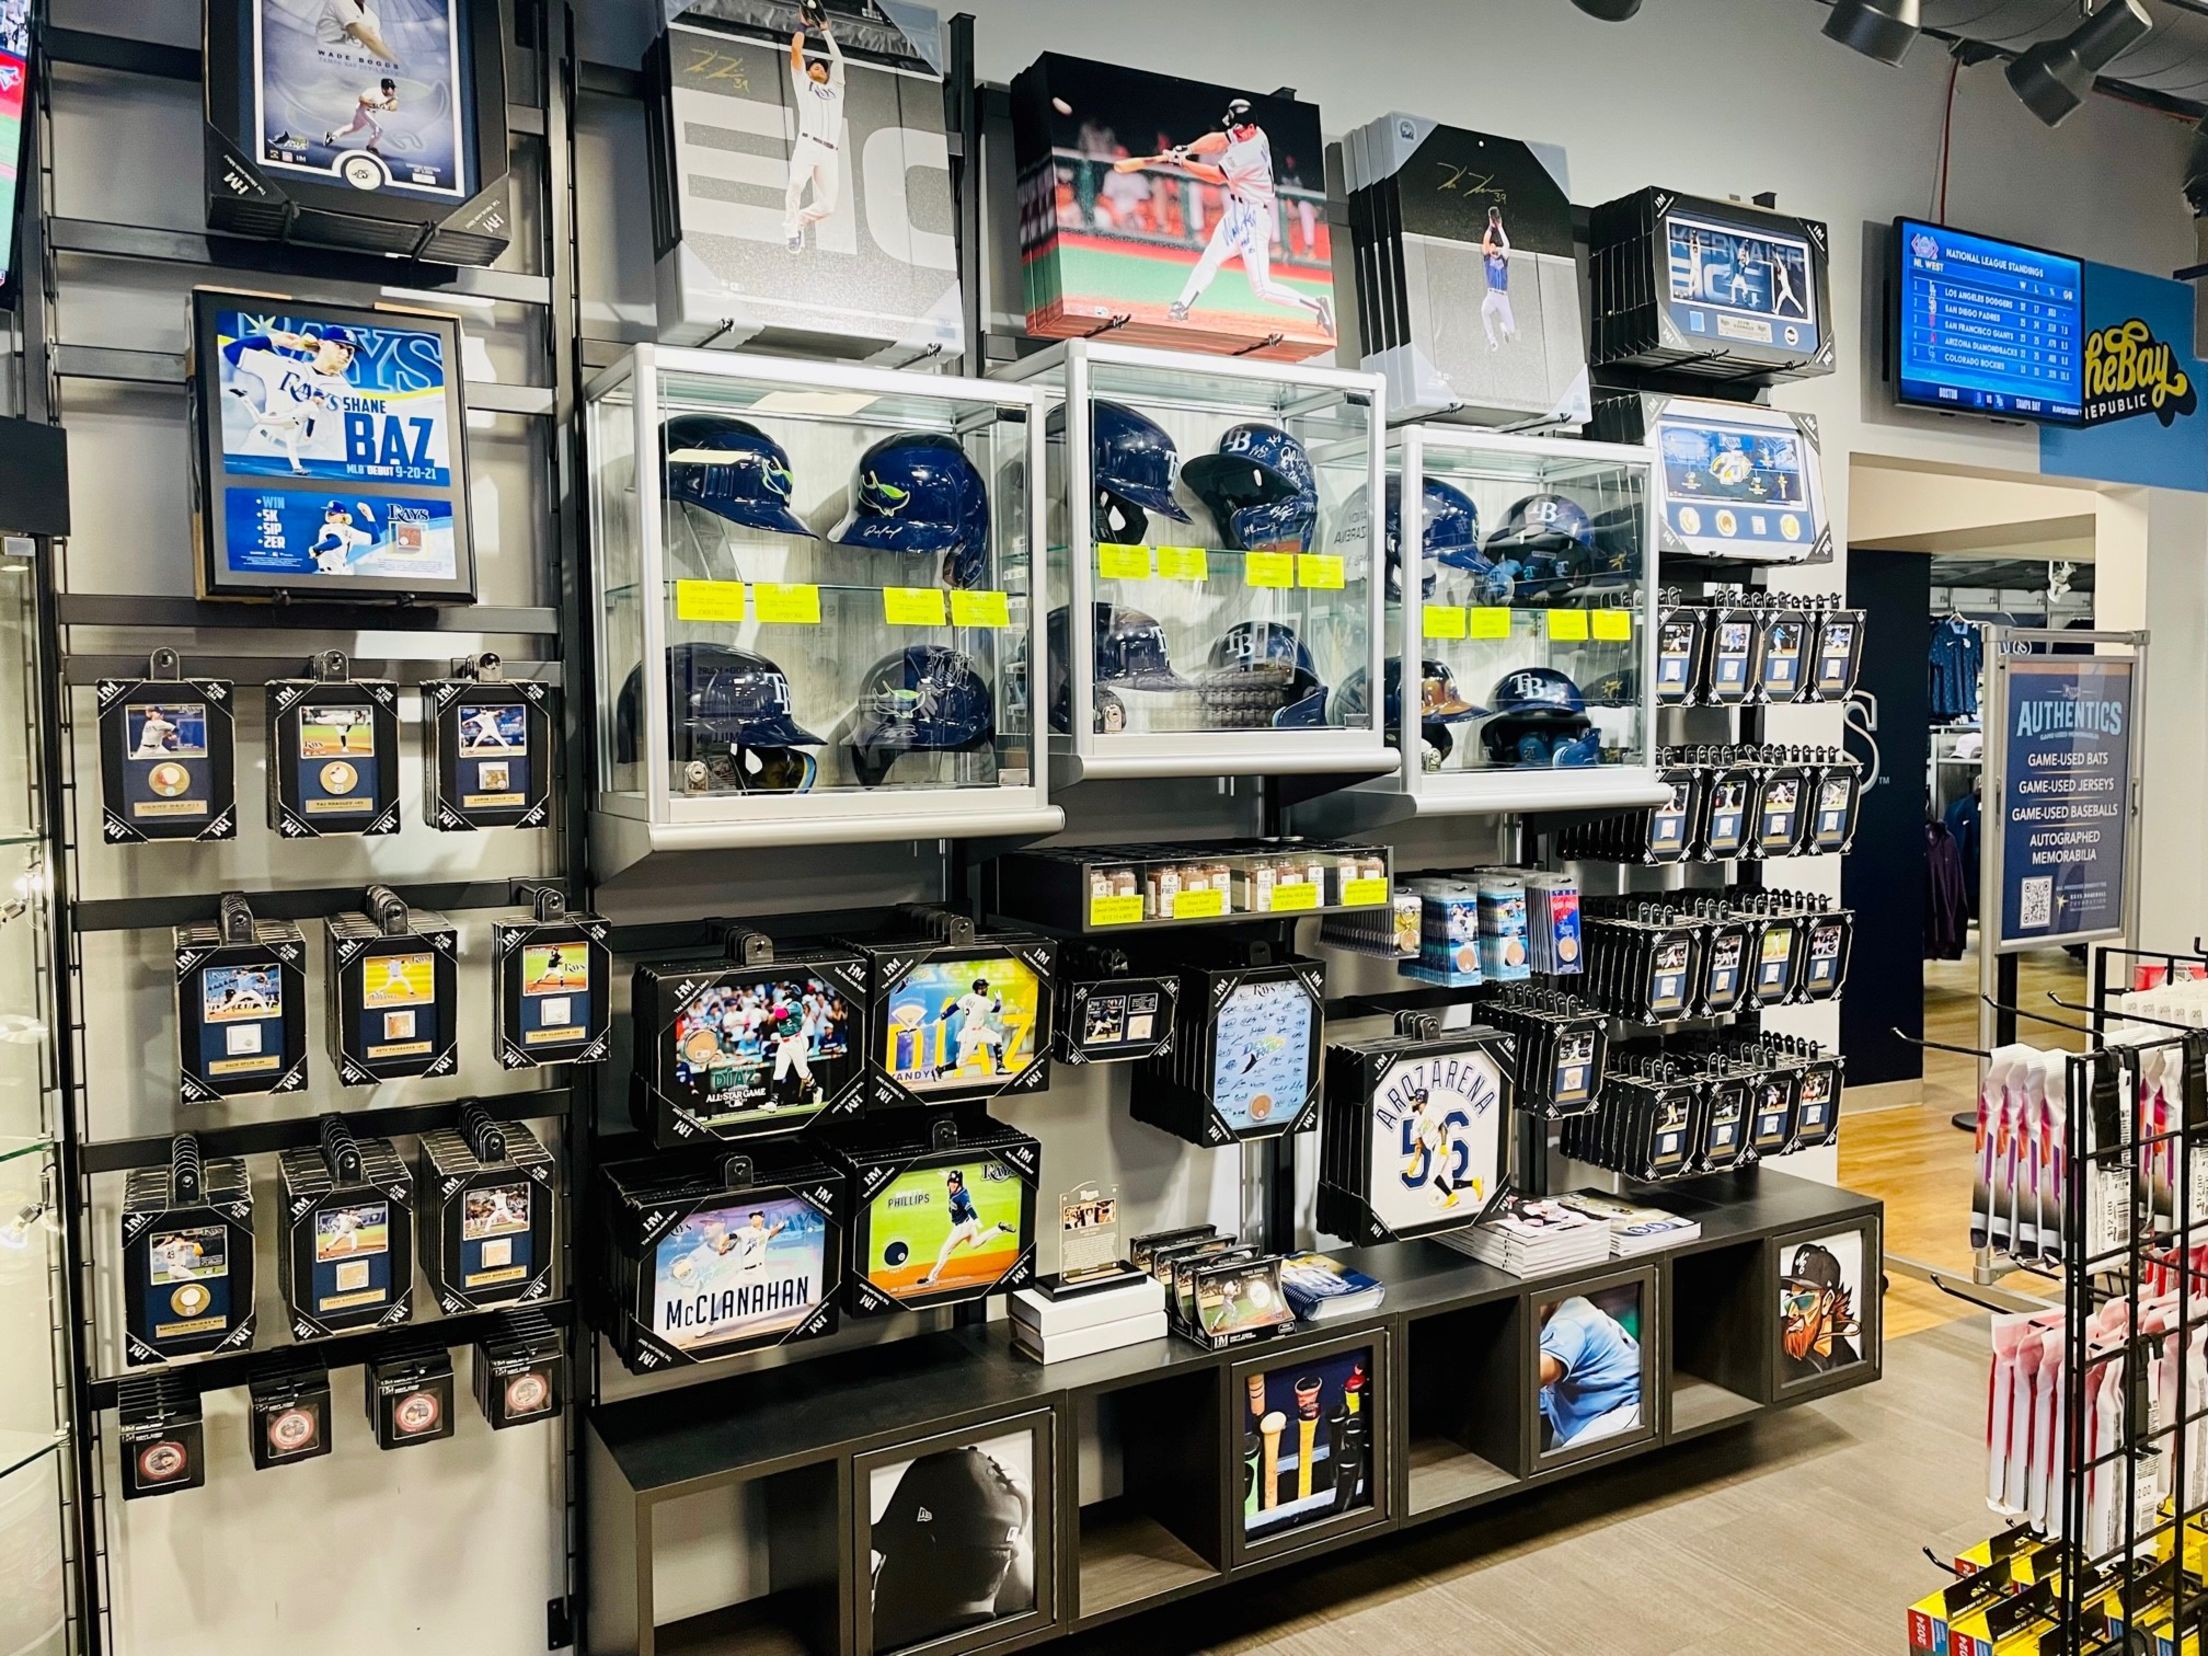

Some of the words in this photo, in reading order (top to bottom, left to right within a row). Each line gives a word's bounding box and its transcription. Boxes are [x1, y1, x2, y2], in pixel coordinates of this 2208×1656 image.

[317, 48, 351, 61] WADE
[358, 57, 400, 70] BOGGS
[223, 172, 250, 195] HM
[482, 213, 505, 233] HM
[1913, 258, 1923, 268] NL
[1925, 260, 1944, 272] WEST
[1945, 248, 1981, 265] NATIONAL
[1981, 256, 2007, 270] LEAGUE
[2007, 262, 2044, 278] STANDINGS
[2019, 281, 2027, 290] W
[1944, 288, 1957, 299] LOS
[1958, 291, 1984, 305] ANGELES
[1984, 295, 2013, 310] DODGERS
[1944, 305, 1958, 315] SAN
[1958, 307, 1978, 318] DIEGO
[1944, 321, 1958, 331] SAN
[1958, 323, 1992, 337] FRANCISCO
[1992, 329, 2014, 340] GIANTS
[1944, 337, 1972, 350] ARIZONA
[1944, 353, 1979, 366] COLORADO
[2084, 320, 2188, 409] heBay
[343, 396, 387, 414] SHANE
[343, 412, 435, 468] BAZ
[367, 465, 394, 477] DEBUT
[395, 467, 437, 480] 9-20-21
[263, 496, 285, 509] WIN
[387, 503, 429, 522] RAYS
[274, 686, 297, 706] HM
[435, 683, 455, 702] HM
[1508, 672, 1547, 701] TB
[2016, 699, 2123, 737] AUTHENTICS
[2027, 752, 2085, 768] GAME-USED
[2086, 751, 2109, 766] BATS
[1878, 776, 1890, 784] TM
[2018, 778, 2077, 794] GAME-USED
[2077, 777, 2115, 792] JERSEYS
[2011, 805, 2069, 822] GAME-USED
[2070, 803, 2118, 818] BASEBALLS
[2029, 830, 2101, 848] AUTOGRAPHED
[2031, 849, 2097, 865] MEMORABILIA
[501, 928, 520, 947] HM
[1033, 947, 1051, 966] HM
[847, 962, 867, 982] HM
[882, 957, 902, 978] HM
[673, 978, 696, 999] HM
[1213, 978, 1229, 996] HM
[1025, 1069, 1043, 1088] HM
[742, 1088, 767, 1098] GAME
[875, 1087, 895, 1105] HM
[1375, 1058, 1496, 1131] AROZARENA
[844, 1095, 864, 1115] HM
[672, 1119, 694, 1139] HM
[1016, 1146, 1035, 1164] HM
[1399, 1108, 1472, 1191] 56
[863, 1166, 883, 1187] HM
[814, 1185, 834, 1204] HM
[887, 1193, 931, 1209] PHILLIPS
[290, 1196, 311, 1216] HM
[124, 1212, 146, 1232] HM
[642, 1210, 664, 1232] HM
[1011, 1267, 1029, 1285] HM
[808, 1314, 828, 1335] HM
[1214, 1334, 1229, 1349] HM
[637, 1350, 659, 1369] HM
[1917, 1615, 1927, 1646] 2024
